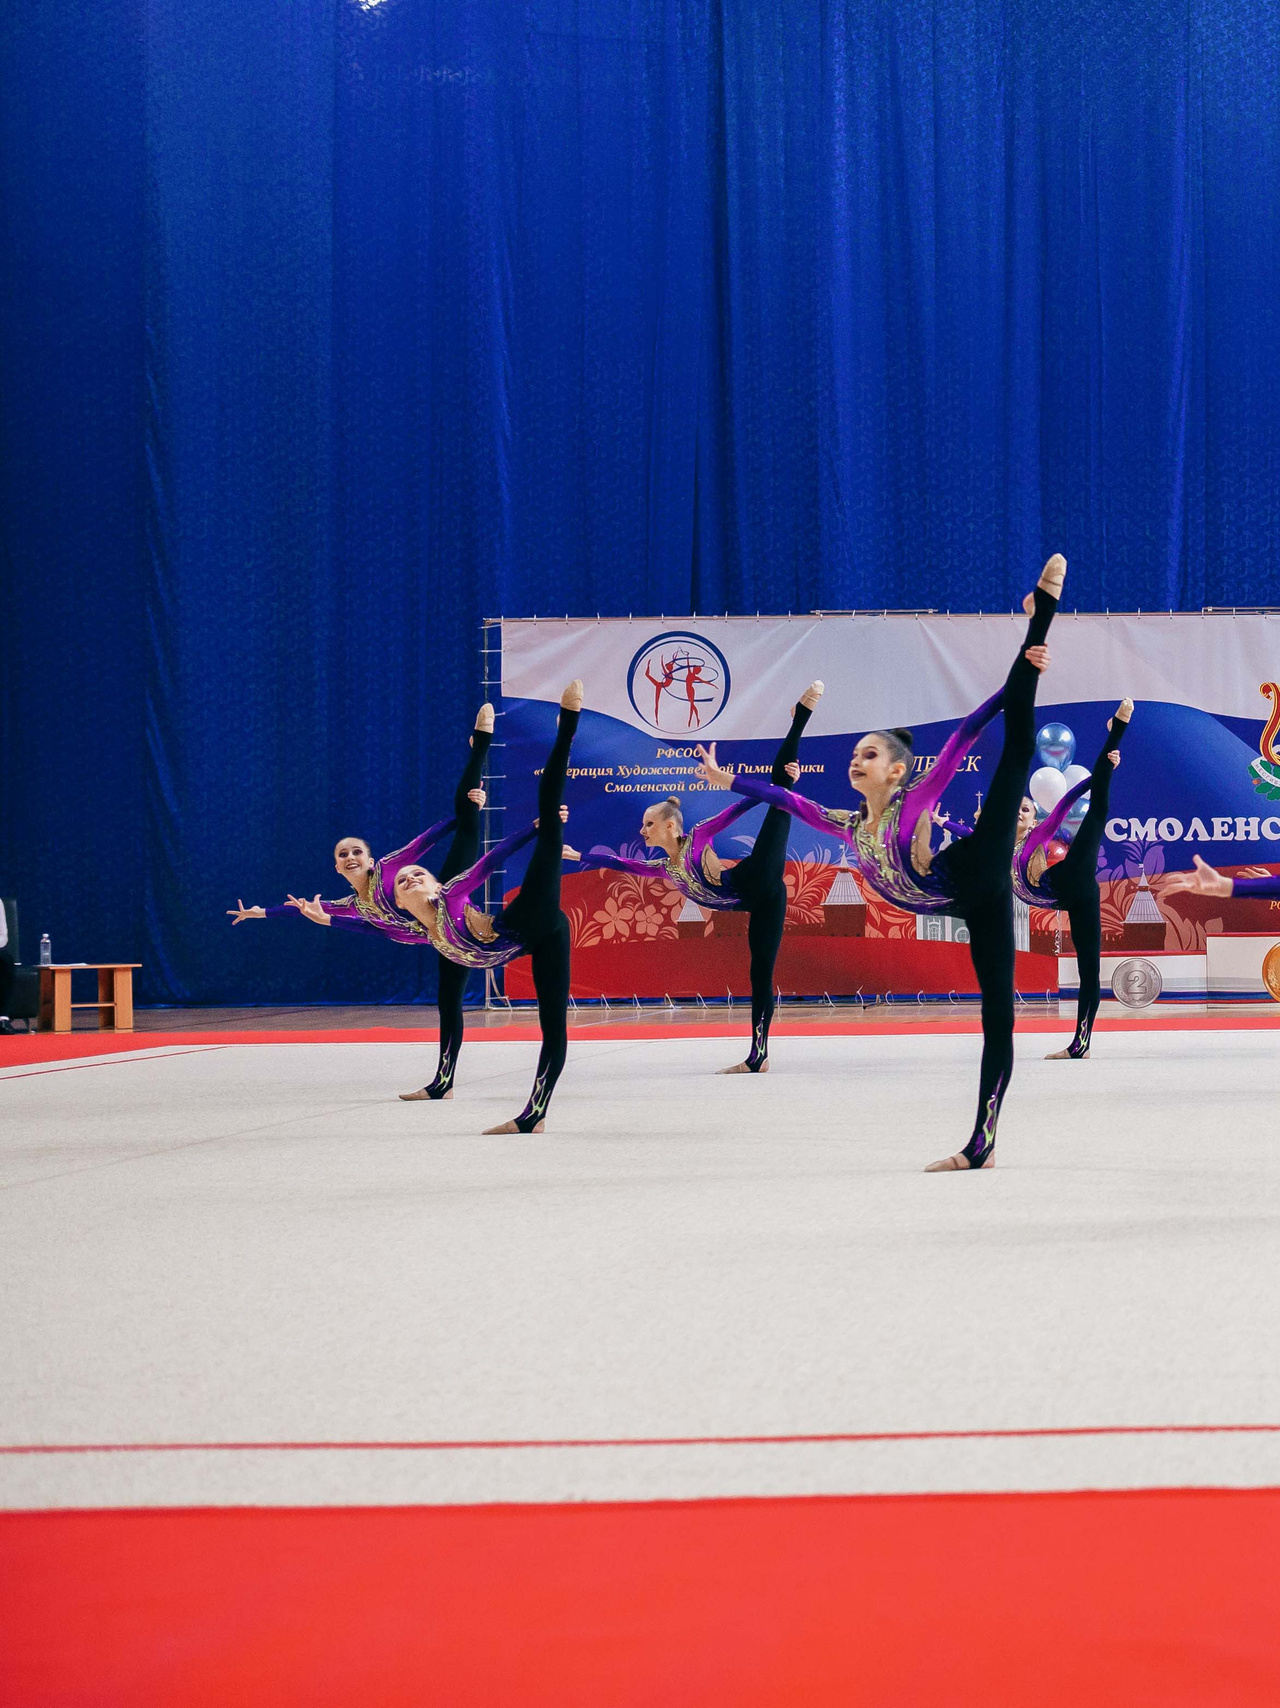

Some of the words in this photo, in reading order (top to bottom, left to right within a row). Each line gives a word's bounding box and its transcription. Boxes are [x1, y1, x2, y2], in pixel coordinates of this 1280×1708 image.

[656, 747, 702, 759] РФСОО
[534, 767, 614, 779] «ерация
[616, 762, 735, 778] Художествеой
[737, 763, 825, 774] Гимники
[604, 781, 686, 793] Смоленской
[1127, 969, 1148, 995] 2
